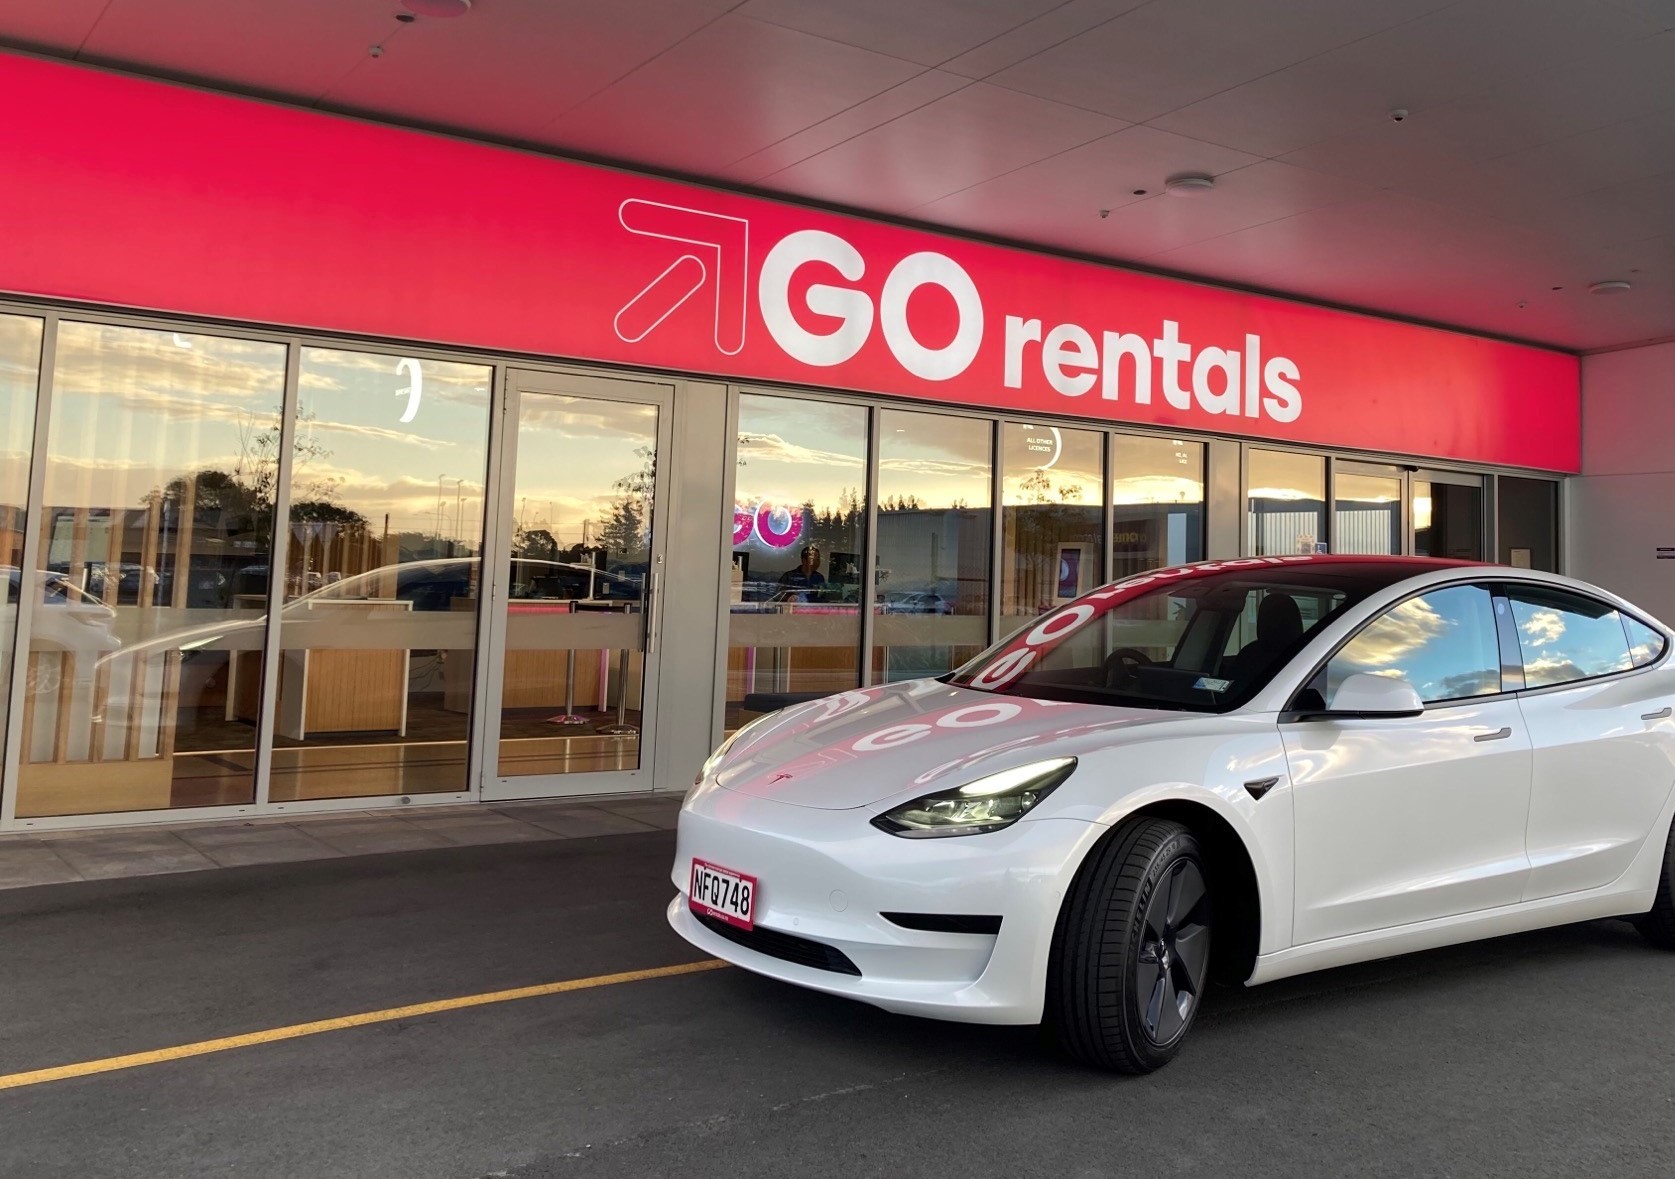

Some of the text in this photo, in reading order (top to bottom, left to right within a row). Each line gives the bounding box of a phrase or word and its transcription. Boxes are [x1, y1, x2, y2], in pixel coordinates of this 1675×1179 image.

[758, 229, 1303, 423] GO rentals
[693, 869, 750, 916] NFQ748
